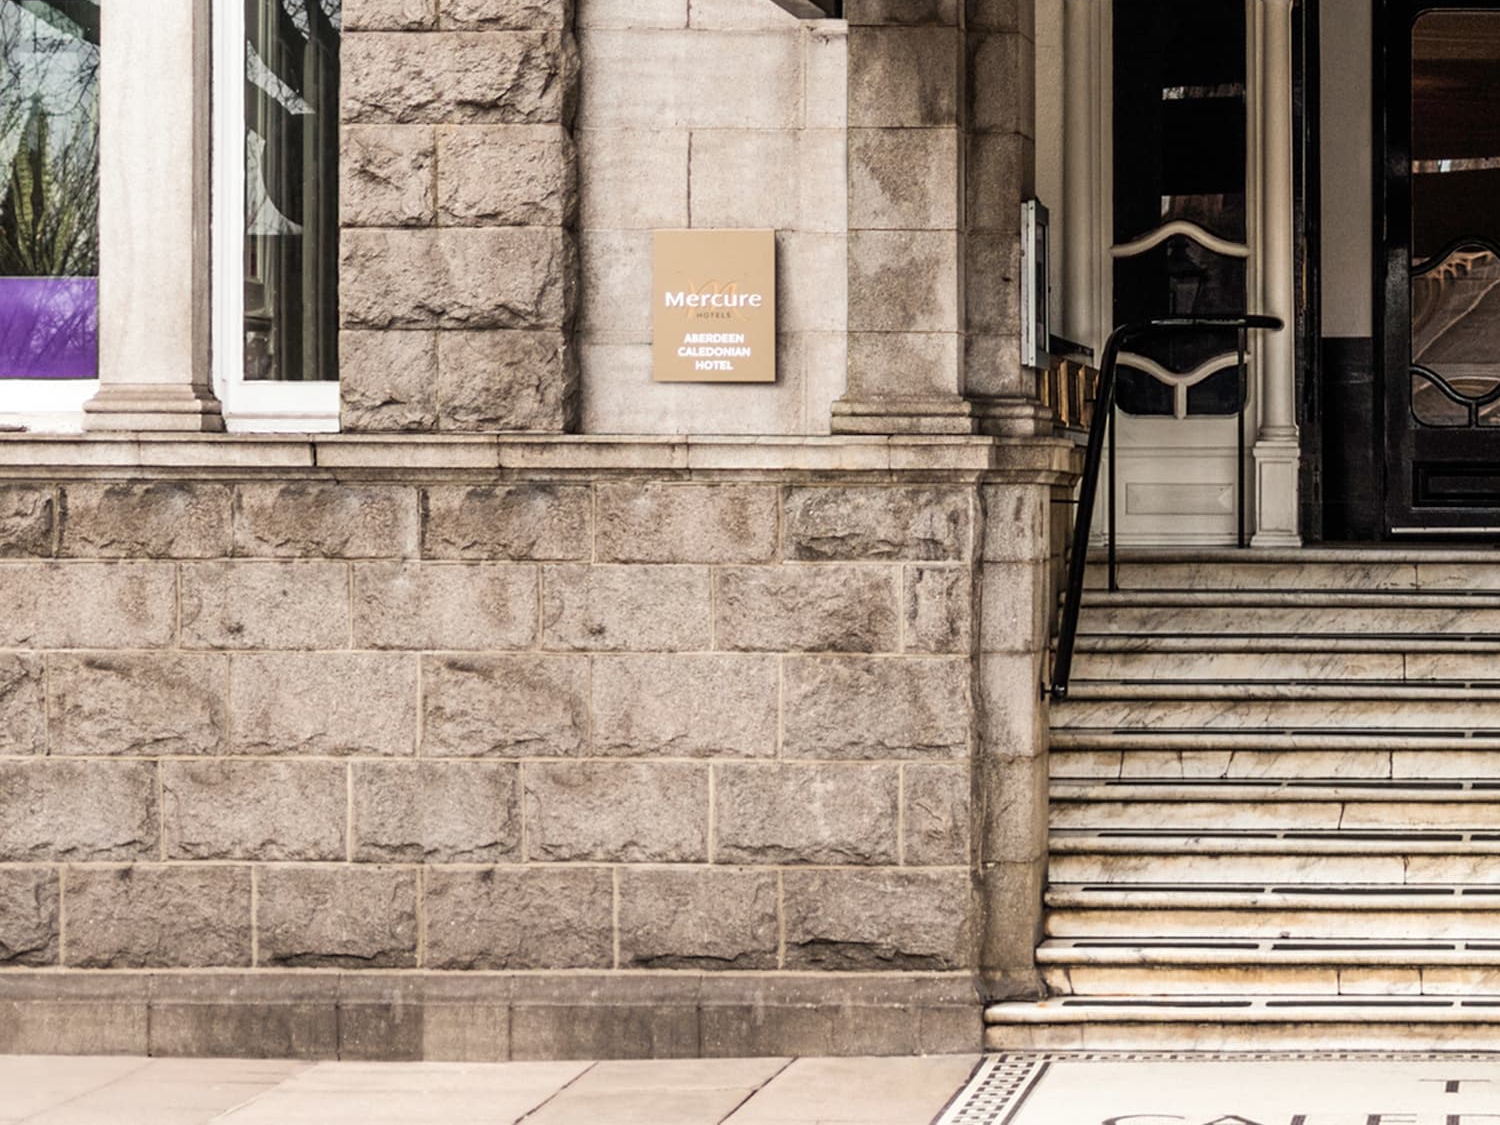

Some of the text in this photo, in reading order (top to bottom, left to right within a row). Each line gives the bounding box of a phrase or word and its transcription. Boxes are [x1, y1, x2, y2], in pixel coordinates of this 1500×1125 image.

[664, 291, 763, 308] Mercure
[696, 311, 732, 320] HOTELS
[684, 333, 745, 344] ABERDEEN
[677, 346, 751, 357] CALEDONIAN
[695, 360, 734, 371] HOTEL
